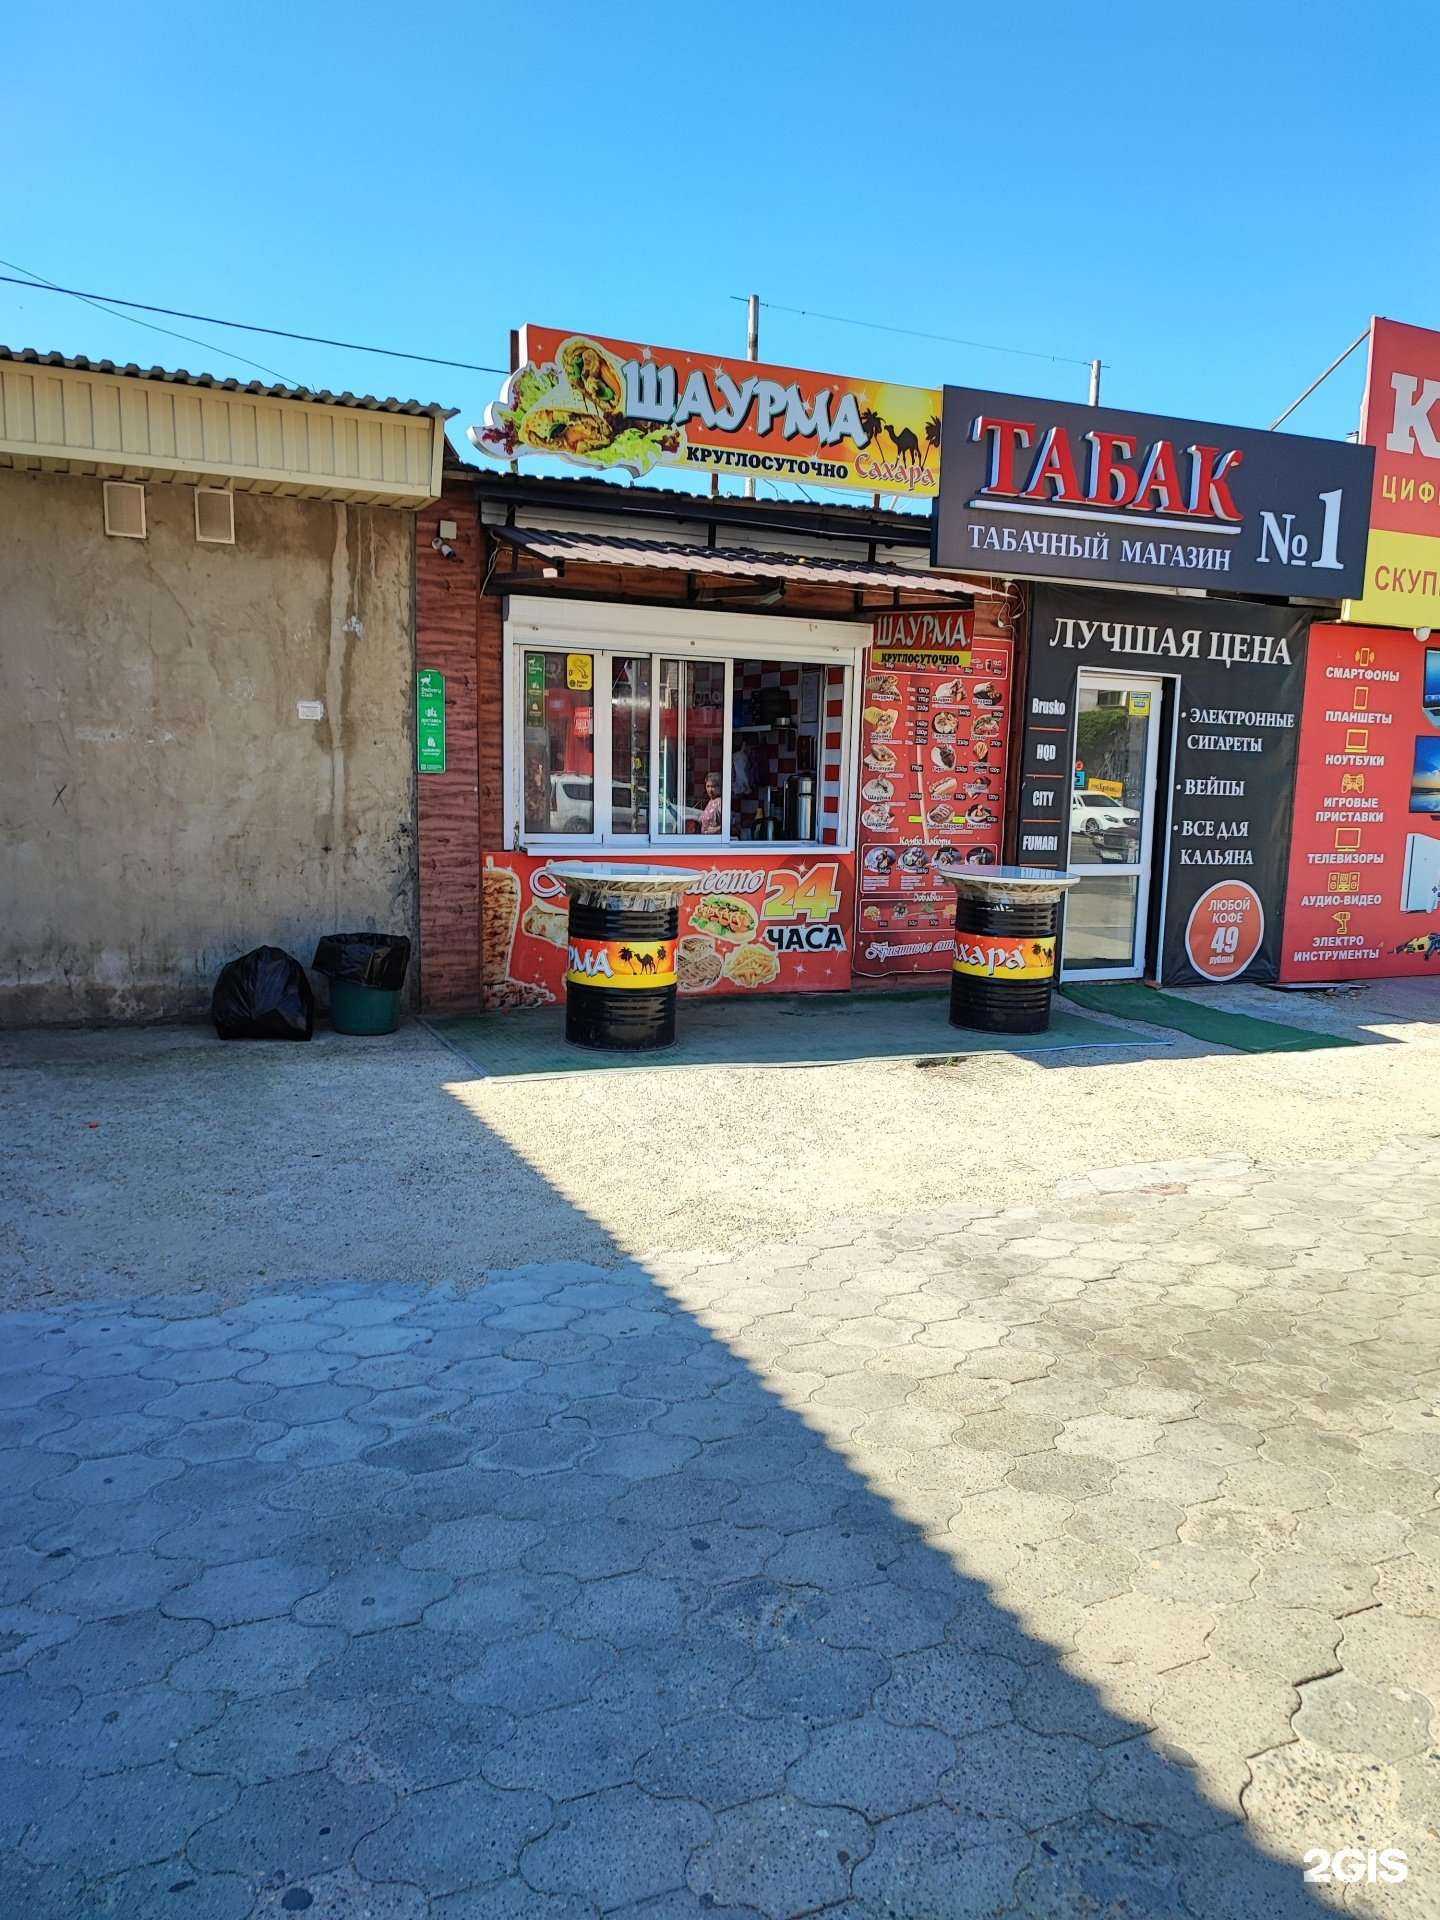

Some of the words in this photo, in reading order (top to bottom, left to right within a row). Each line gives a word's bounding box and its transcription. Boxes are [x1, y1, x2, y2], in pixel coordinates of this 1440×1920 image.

[621, 359, 872, 450] ШАУРМА
[686, 446, 849, 480] КРУГЛОСУТОЧНО
[855, 453, 936, 491] Сахара
[970, 416, 1245, 522] ТАБАК
[1382, 475, 1440, 504] ЦИФ
[967, 524, 1110, 562] ТАБАЧНЫЙ
[1120, 539, 1232, 572] МАГАЗИН
[1374, 564, 1440, 597] СКУП
[876, 615, 971, 648] ШАУРМА
[1049, 618, 1203, 658] ЛУЧШАЯ
[1207, 631, 1292, 669] ЦЕНА
[881, 653, 960, 666] КРУГЛОСУТОЧНО
[1325, 666, 1400, 682] СМАРТФОНЫ
[1031, 697, 1066, 716] Brusko
[1189, 708, 1296, 728] ЭЛЕКТРОННЫЕ
[1325, 710, 1393, 724] ПЛАНШЕТЫ
[1187, 734, 1263, 752] СИГАРЕТЫ
[1036, 744, 1057, 761] HQD
[1325, 754, 1385, 767] НОУТБУКИ
[1184, 776, 1246, 798] ВЕЙПЫ
[1032, 790, 1055, 807] CITY
[1323, 797, 1379, 808] ИГРОВЫЕ
[1315, 811, 1384, 823] ПРИСТАВКИ
[1181, 820, 1215, 837] ВСЕ
[1217, 821, 1250, 841] ДЛЯ
[1022, 835, 1058, 851] FUMARI
[1180, 849, 1254, 865] КАЛЬЯНА
[1307, 853, 1384, 864] ТЕЛЕВИЗОРЫ
[762, 863, 840, 920] 24
[1208, 897, 1250, 911] ЛЮБОЙ
[1300, 895, 1382, 907] АУДИО-ВИДЕО
[1212, 912, 1244, 924] КОФЕ
[767, 926, 843, 950] ЧАСА
[1211, 926, 1239, 953] 49
[1312, 935, 1364, 947] ЭЛЕКТРО
[1293, 949, 1379, 961] ИНСТРУМЕНТЫ
